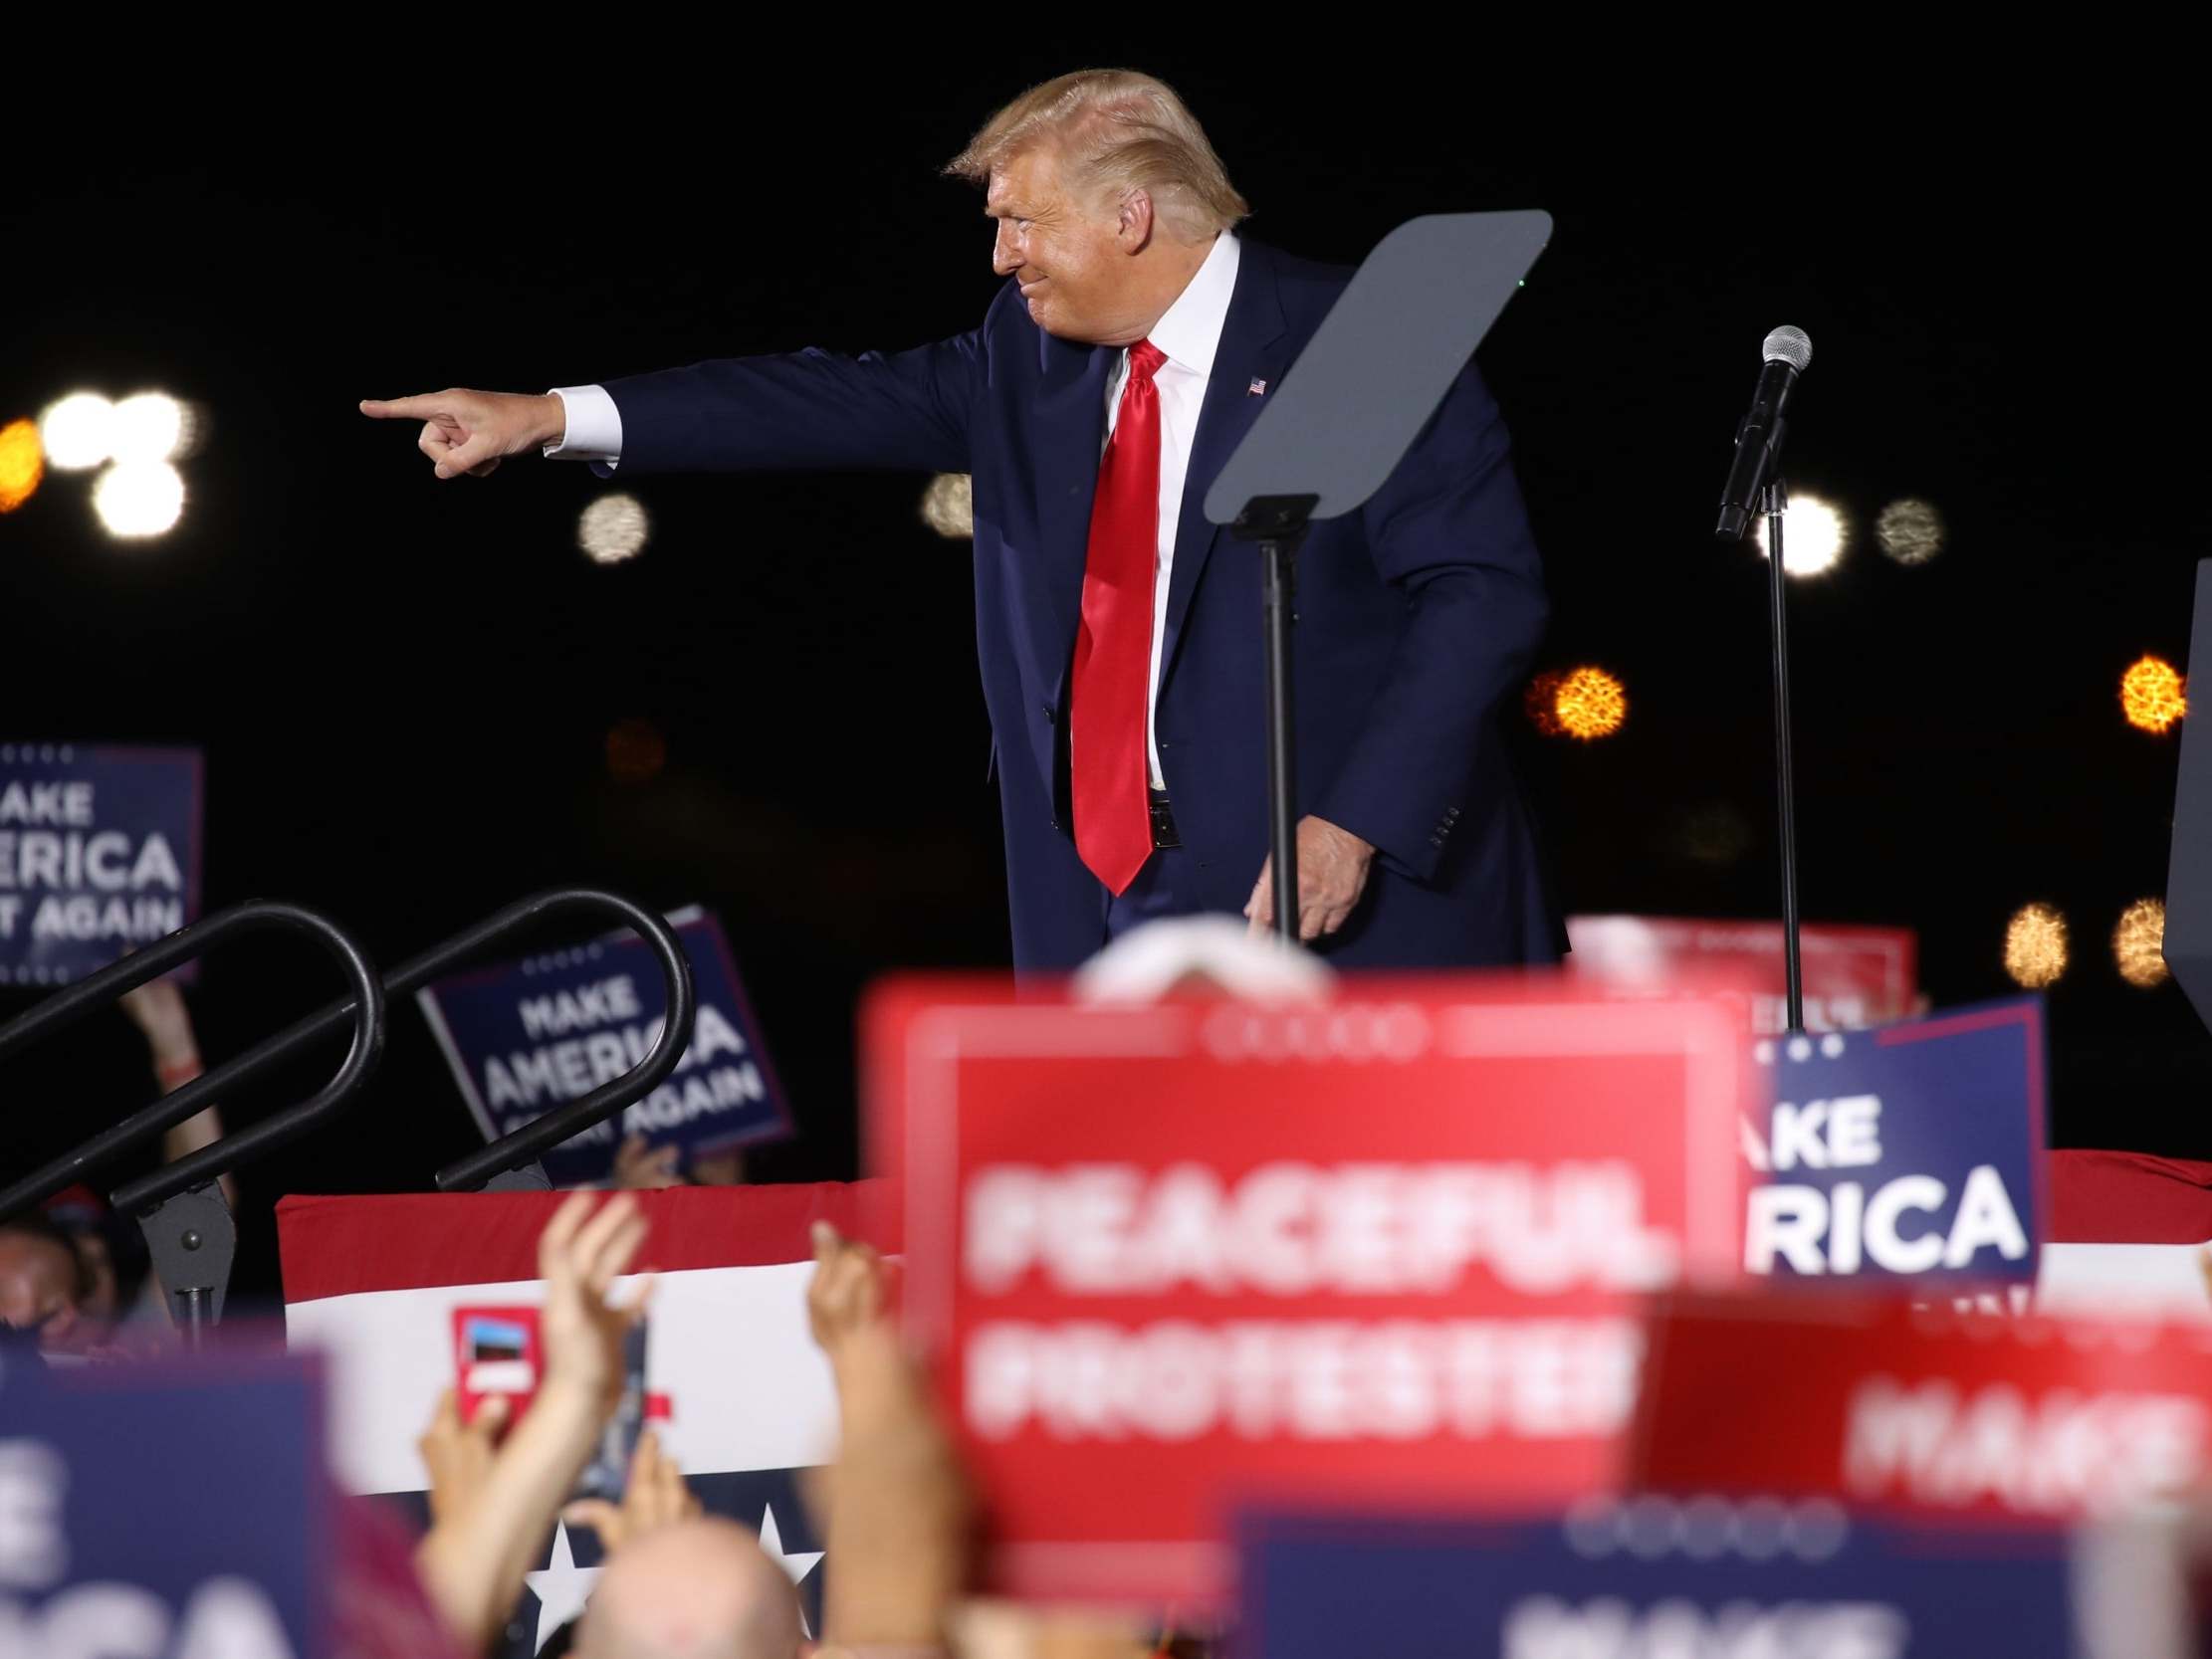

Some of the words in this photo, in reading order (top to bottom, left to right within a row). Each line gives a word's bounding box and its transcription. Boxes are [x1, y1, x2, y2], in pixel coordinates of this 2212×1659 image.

[0, 781, 95, 827] AKE
[32, 893, 183, 941] AGAIN
[518, 974, 642, 1040] MAKE
[622, 1062, 766, 1134] AGAIN
[964, 1162, 1679, 1294] PEACEFUL
[1744, 1163, 2030, 1276] RICA
